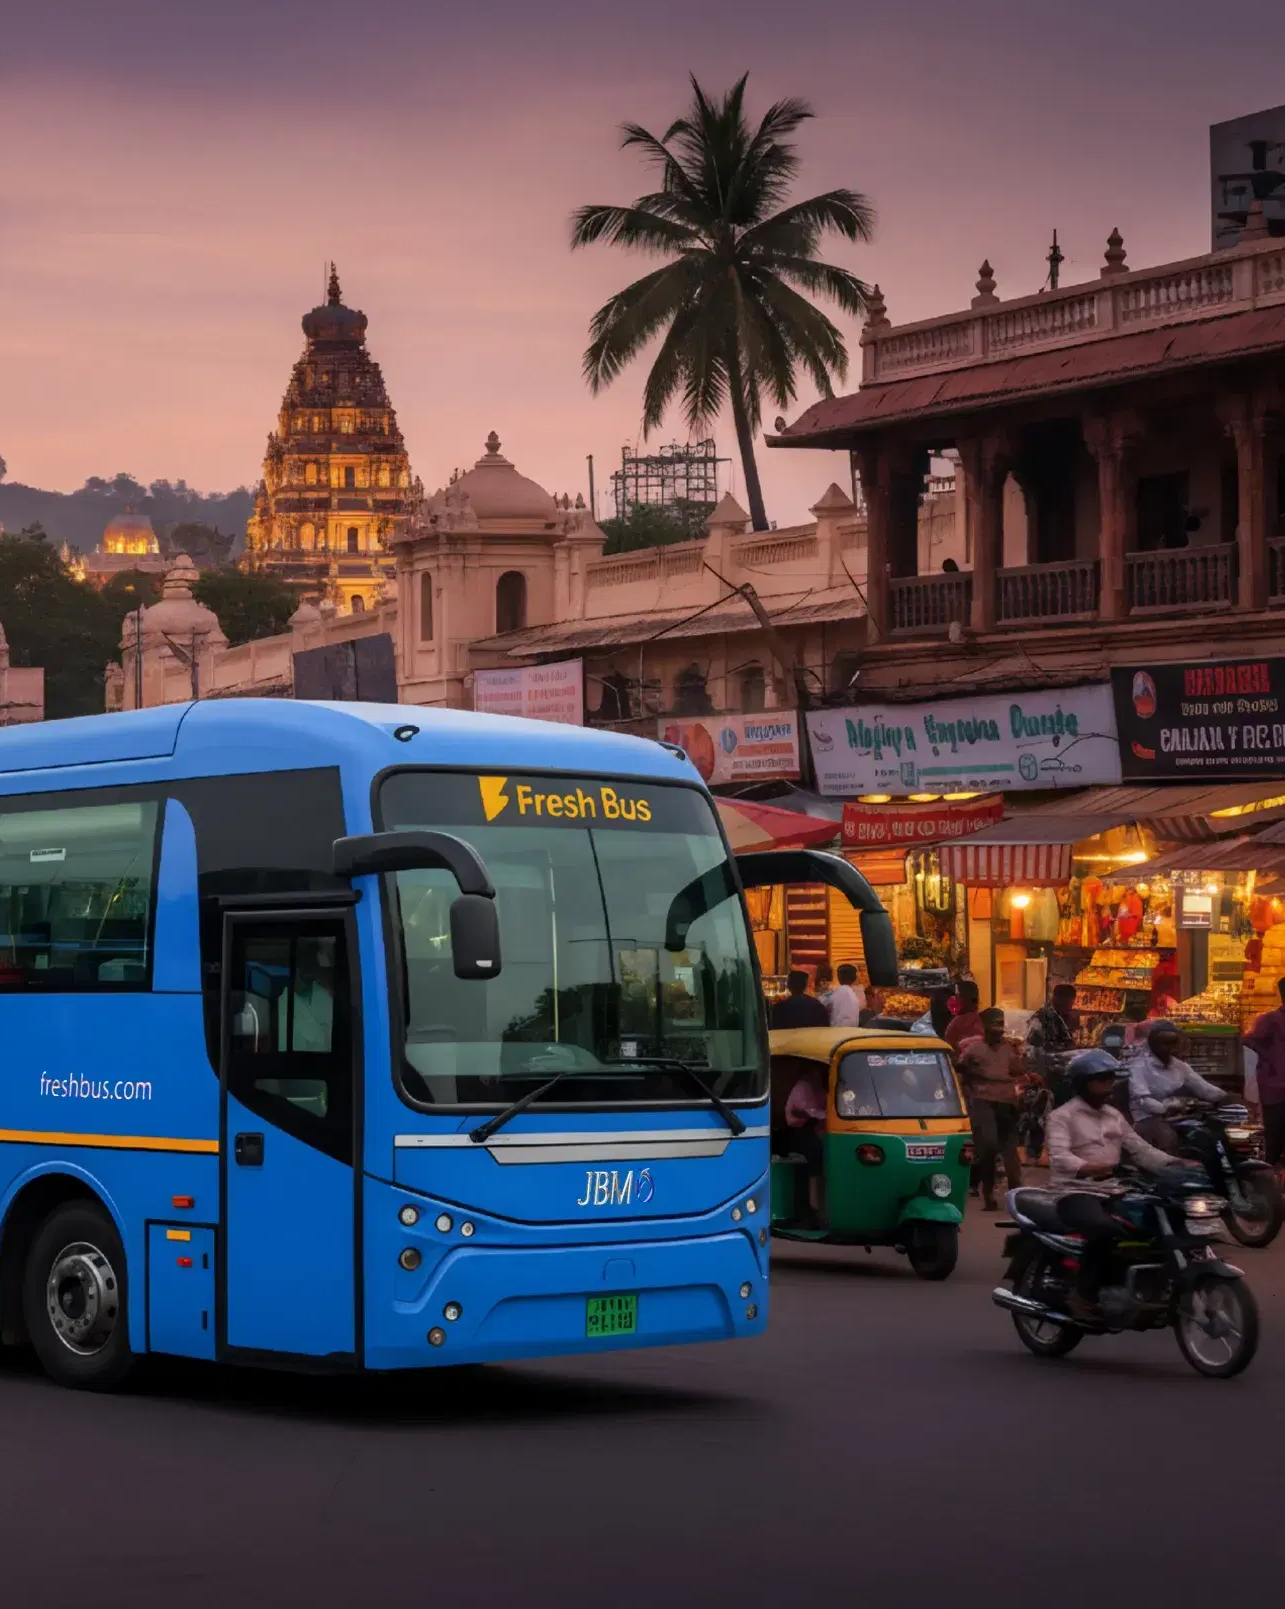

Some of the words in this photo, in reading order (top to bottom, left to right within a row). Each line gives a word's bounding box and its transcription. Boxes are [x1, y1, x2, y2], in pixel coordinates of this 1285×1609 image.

[515, 784, 597, 819] Fresh
[600, 787, 652, 822] Bus
[39, 1070, 153, 1101] freshbus.com
[577, 1170, 634, 1206] JBM
